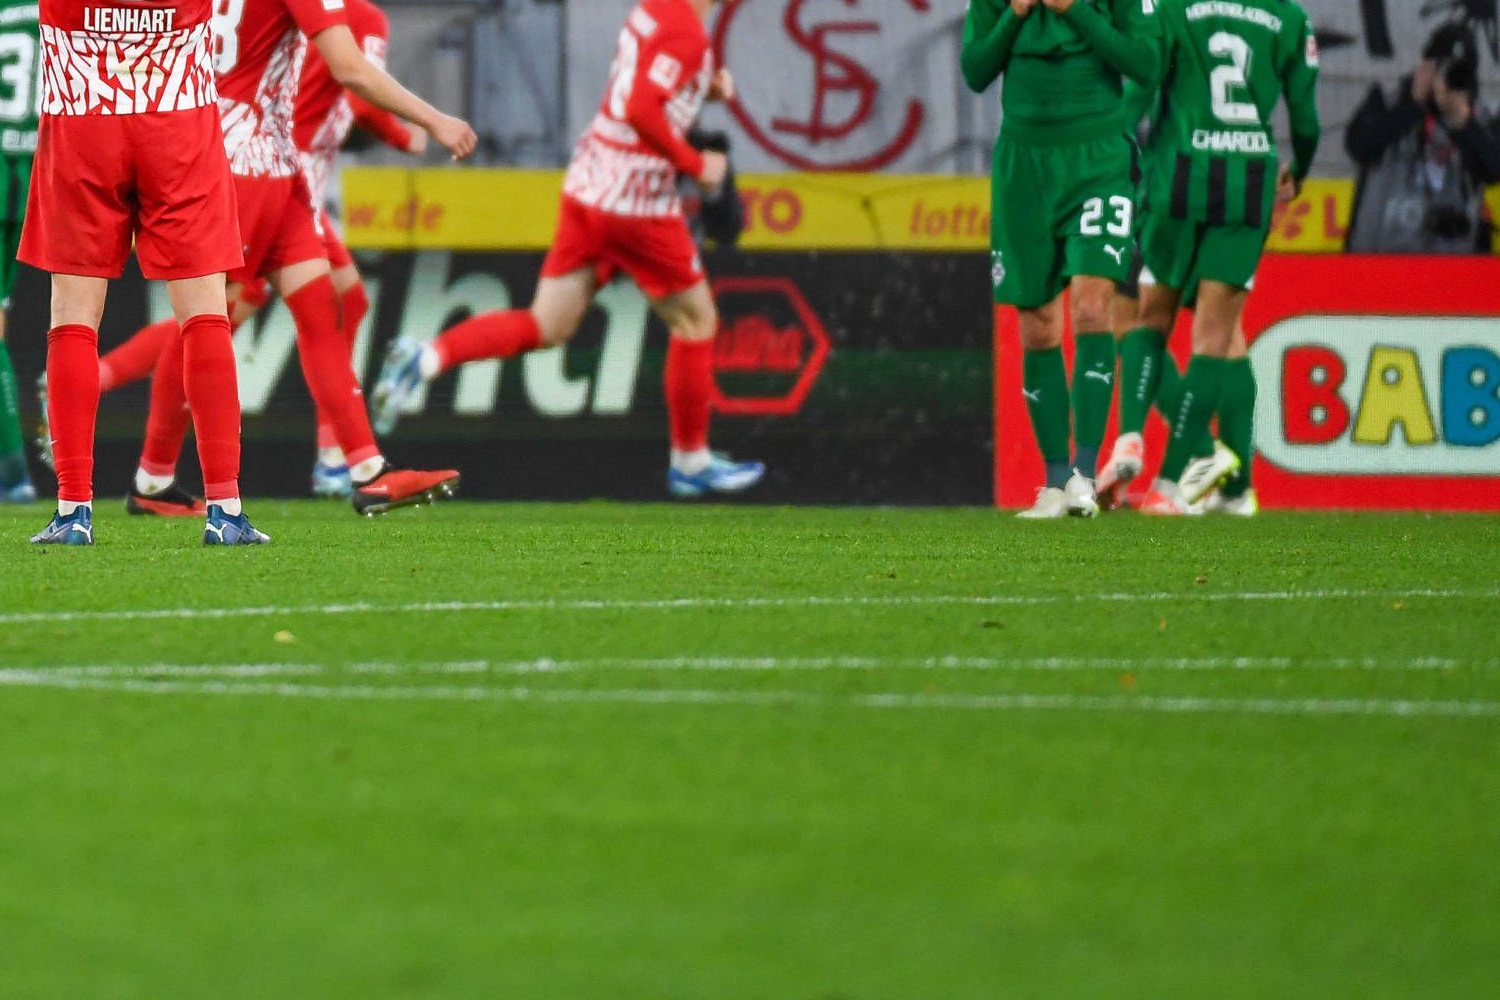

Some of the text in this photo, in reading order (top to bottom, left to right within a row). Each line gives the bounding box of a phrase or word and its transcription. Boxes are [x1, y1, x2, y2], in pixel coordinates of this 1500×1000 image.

[83, 6, 176, 33] LIENHART
[1208, 31, 1261, 125] 2
[1080, 195, 1133, 238] 23
[1281, 344, 1500, 447] BAB
